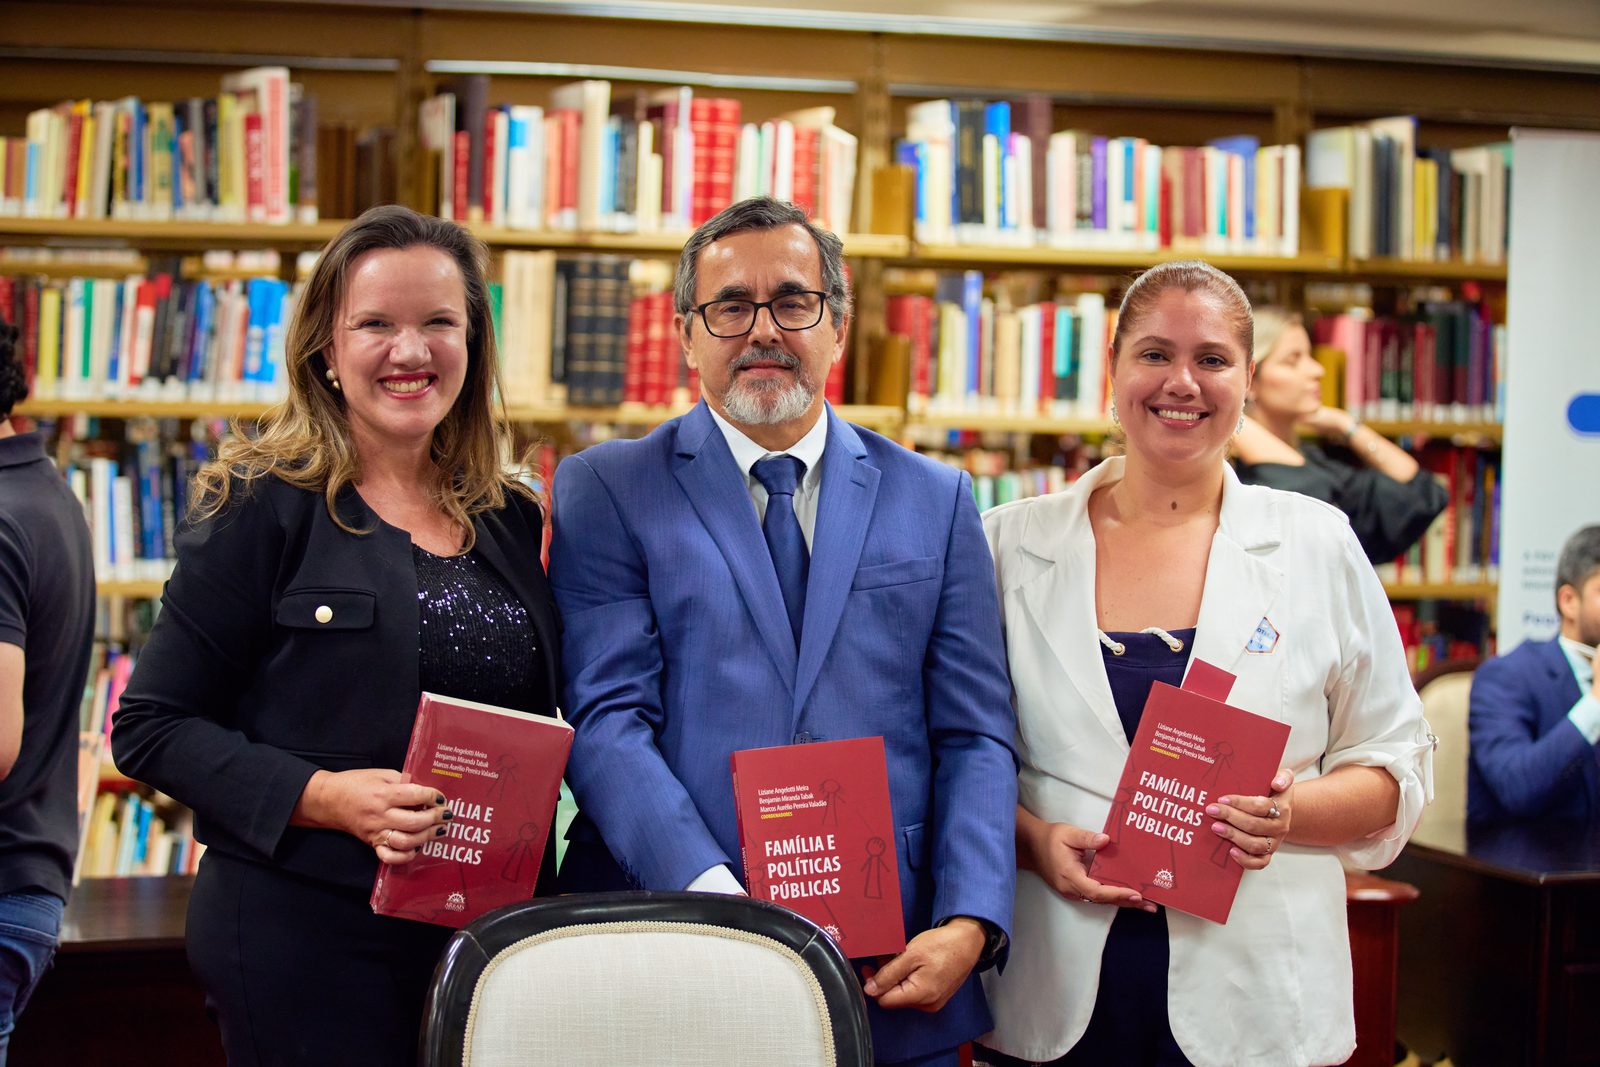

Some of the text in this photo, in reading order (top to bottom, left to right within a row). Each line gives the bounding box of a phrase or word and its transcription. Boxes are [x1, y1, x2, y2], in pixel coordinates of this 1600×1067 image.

[1152, 739, 1168, 748] Marcos
[1168, 744, 1182, 753] Aurélio
[1183, 749, 1197, 758] Pereira
[1155, 730, 1175, 741] Benjamin
[1175, 738, 1193, 748] Miranda
[433, 760, 449, 768] Marcos
[465, 767, 481, 775] Pereira
[435, 752, 456, 761] Benjamin
[457, 756, 475, 765] Miranda
[1140, 771, 1208, 806] FAMÍLIA E
[484, 807, 494, 823] E
[777, 803, 792, 811] Aurélio
[1133, 791, 1203, 826] POLÍTICAS
[1126, 811, 1194, 845] PÚBLICAS
[422, 841, 482, 865] ÚBLICAS
[765, 834, 836, 856] FAMÍLIA E
[768, 856, 841, 878] POLÍTICAS
[770, 878, 840, 900] PÚBLICAS
